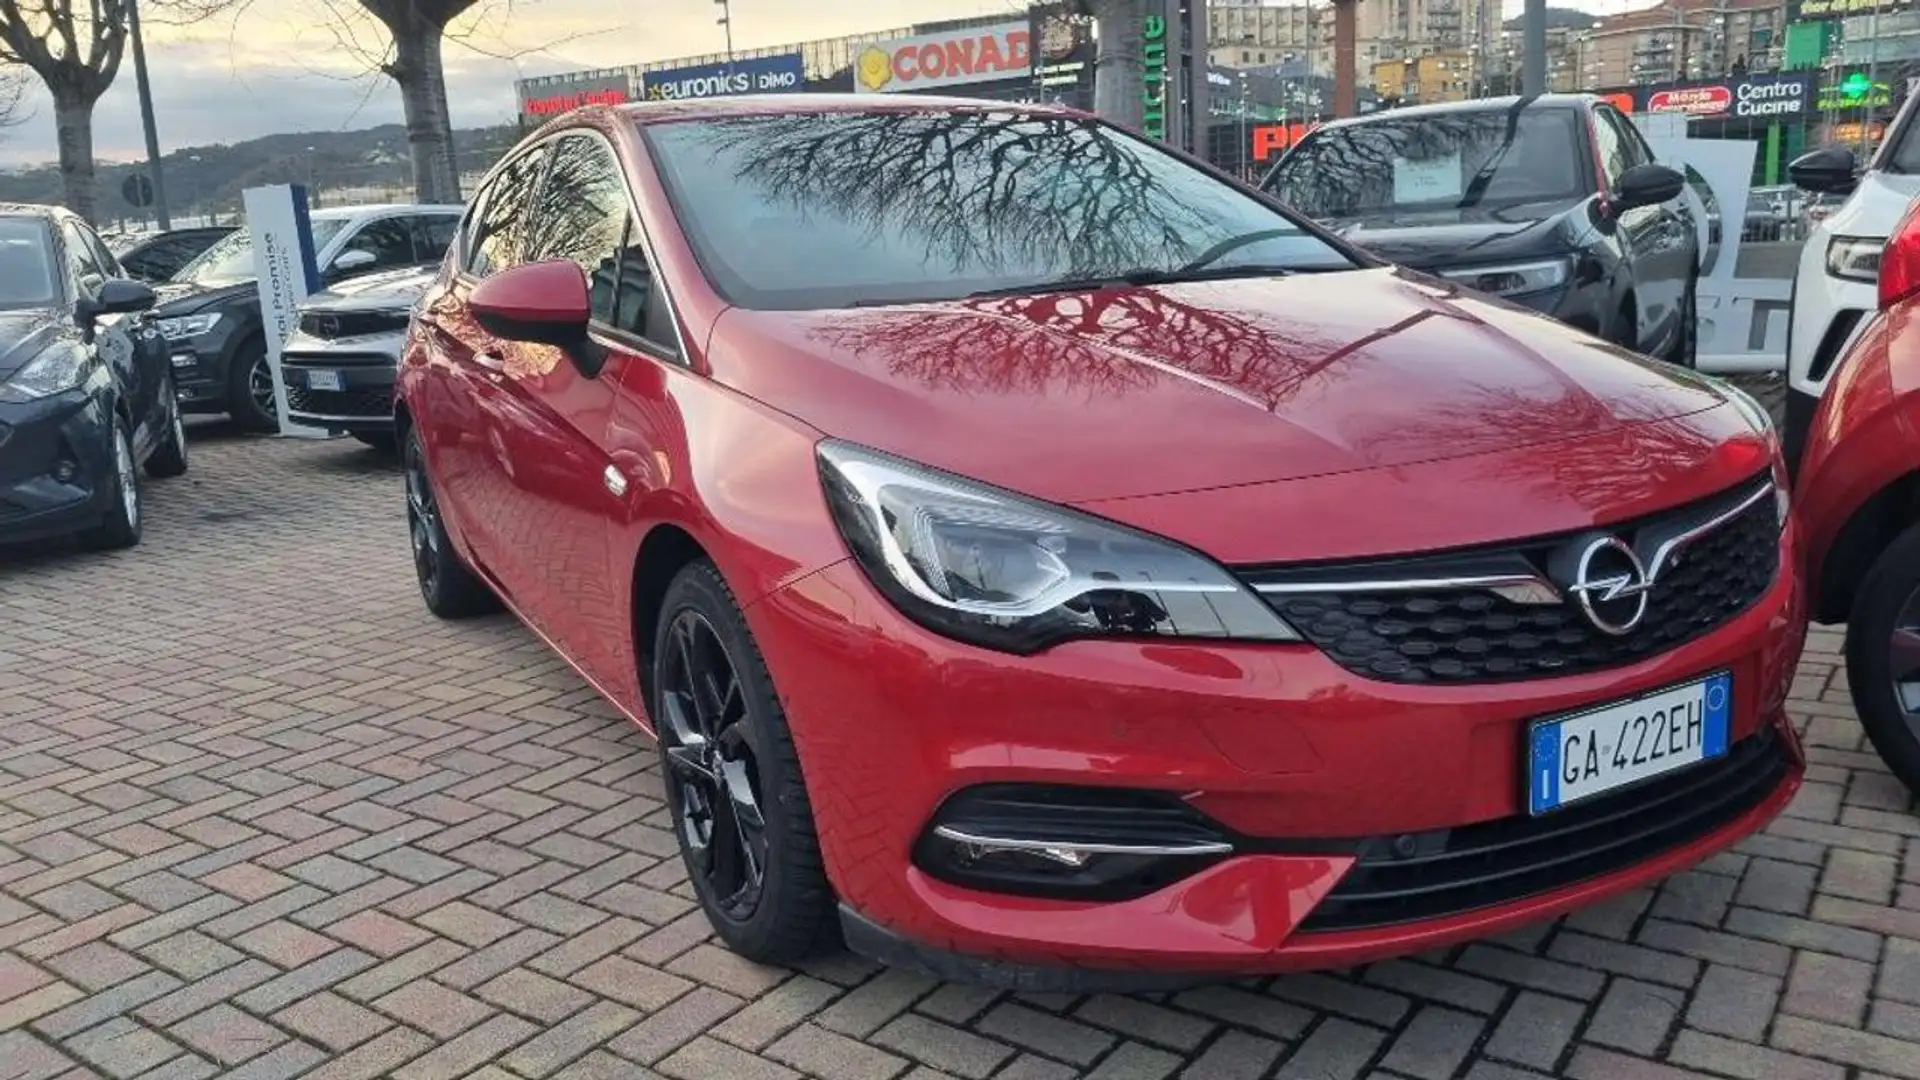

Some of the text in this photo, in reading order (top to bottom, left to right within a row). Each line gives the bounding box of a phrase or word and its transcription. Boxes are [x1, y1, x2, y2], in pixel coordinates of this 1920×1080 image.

[891, 29, 1031, 81] CONAD
[661, 69, 750, 100] euronics
[1737, 82, 1802, 101] Centro
[1737, 99, 1801, 116] Cucine
